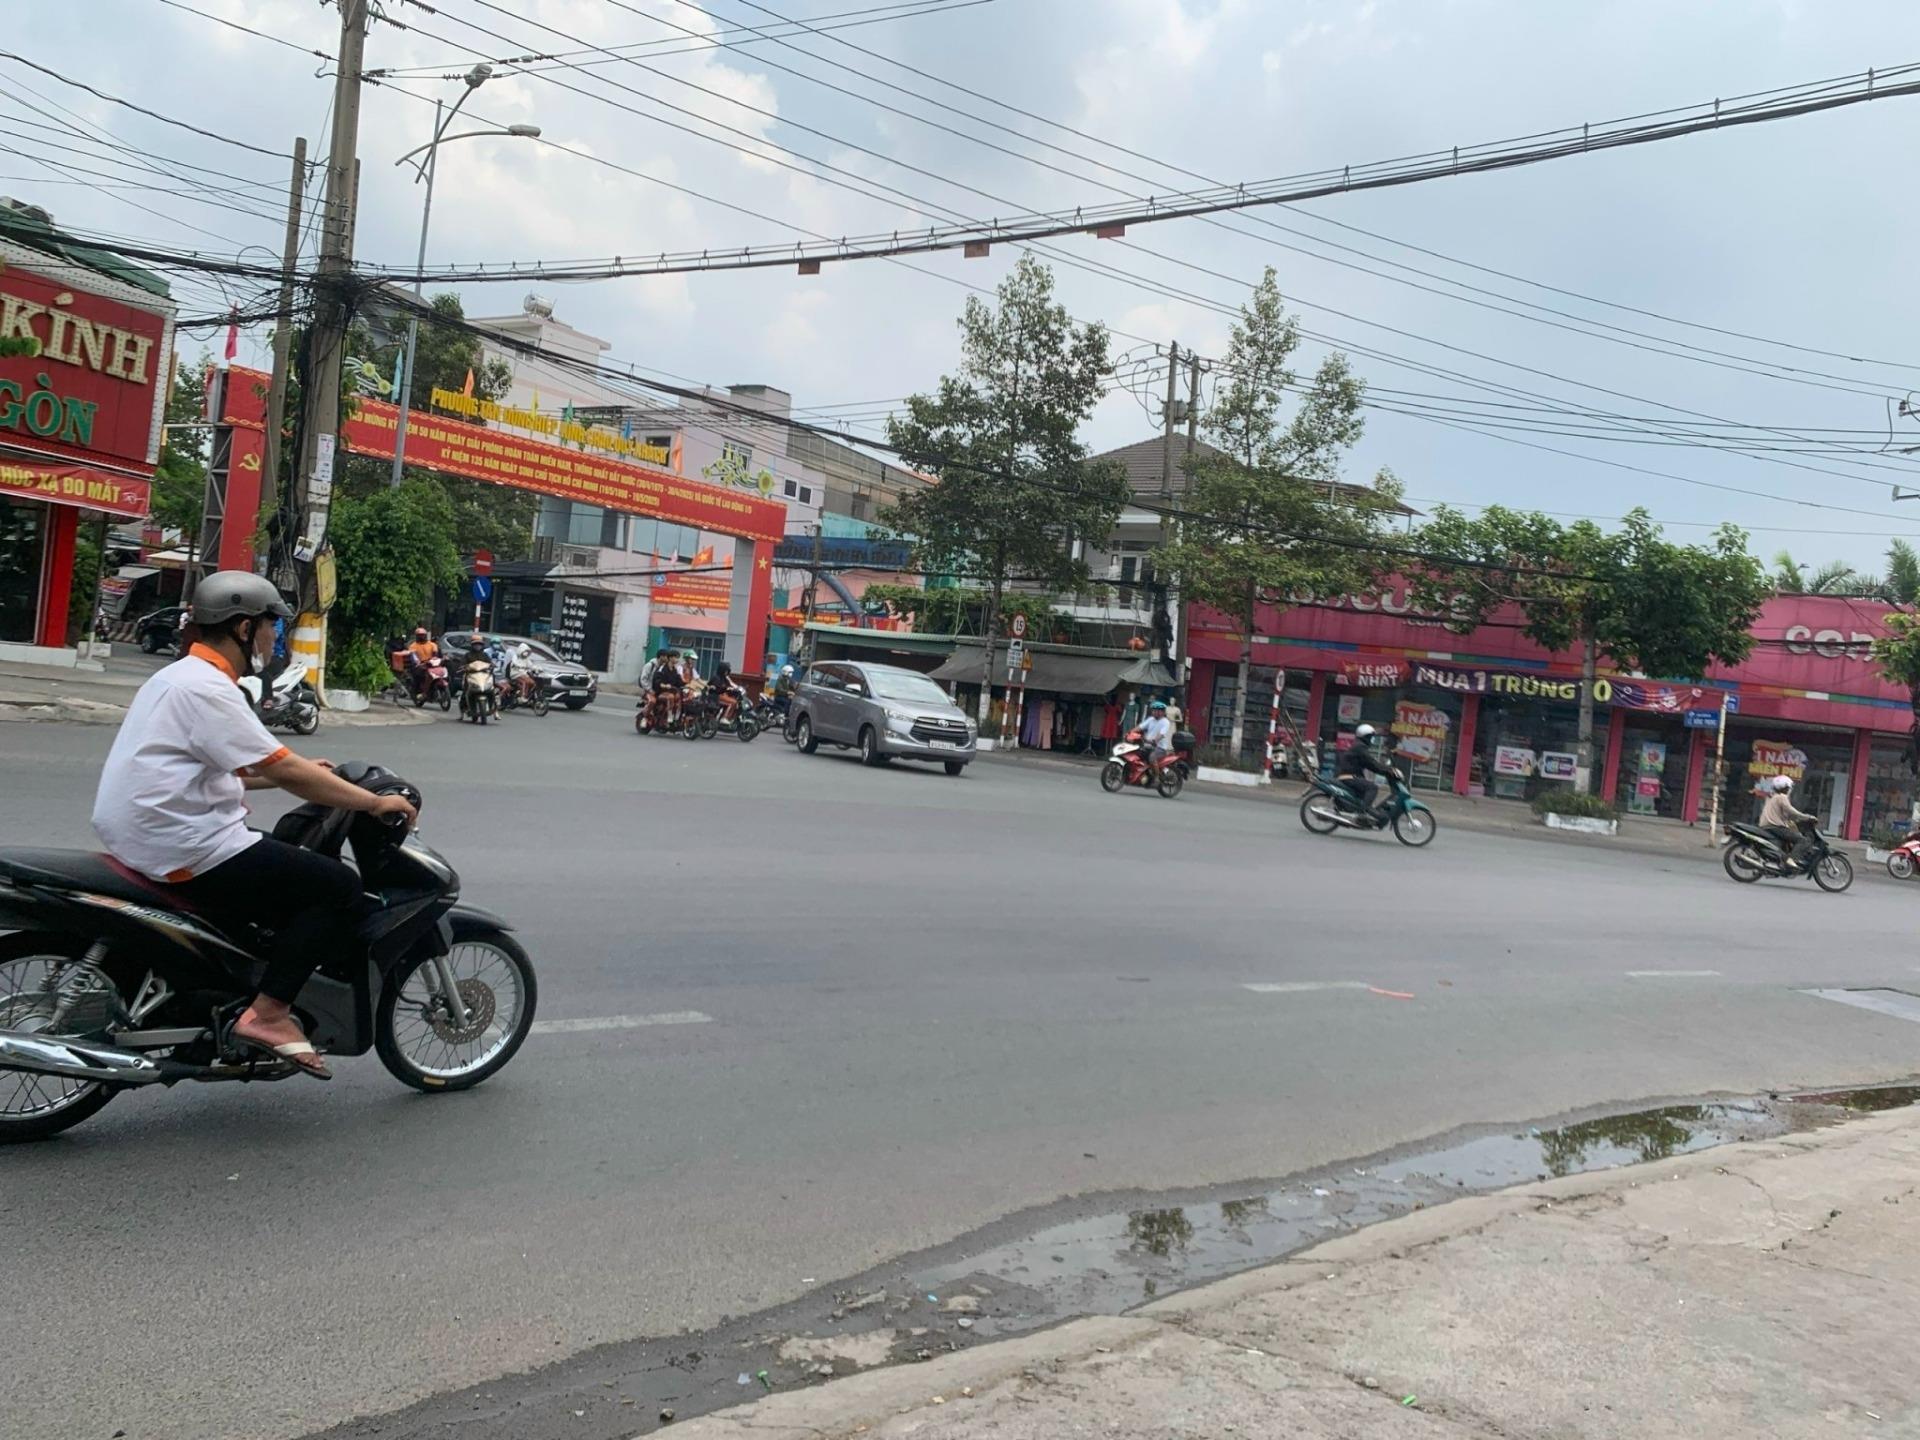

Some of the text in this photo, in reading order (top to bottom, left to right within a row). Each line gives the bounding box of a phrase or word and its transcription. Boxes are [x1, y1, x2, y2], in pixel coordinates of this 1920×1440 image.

[0, 292, 154, 385] KÍNH
[0, 372, 99, 446] GÒN
[63, 477, 85, 496] ĐO
[87, 478, 121, 504] MẮT
[1417, 666, 1470, 690] MUA
[1473, 671, 1487, 692] 1
